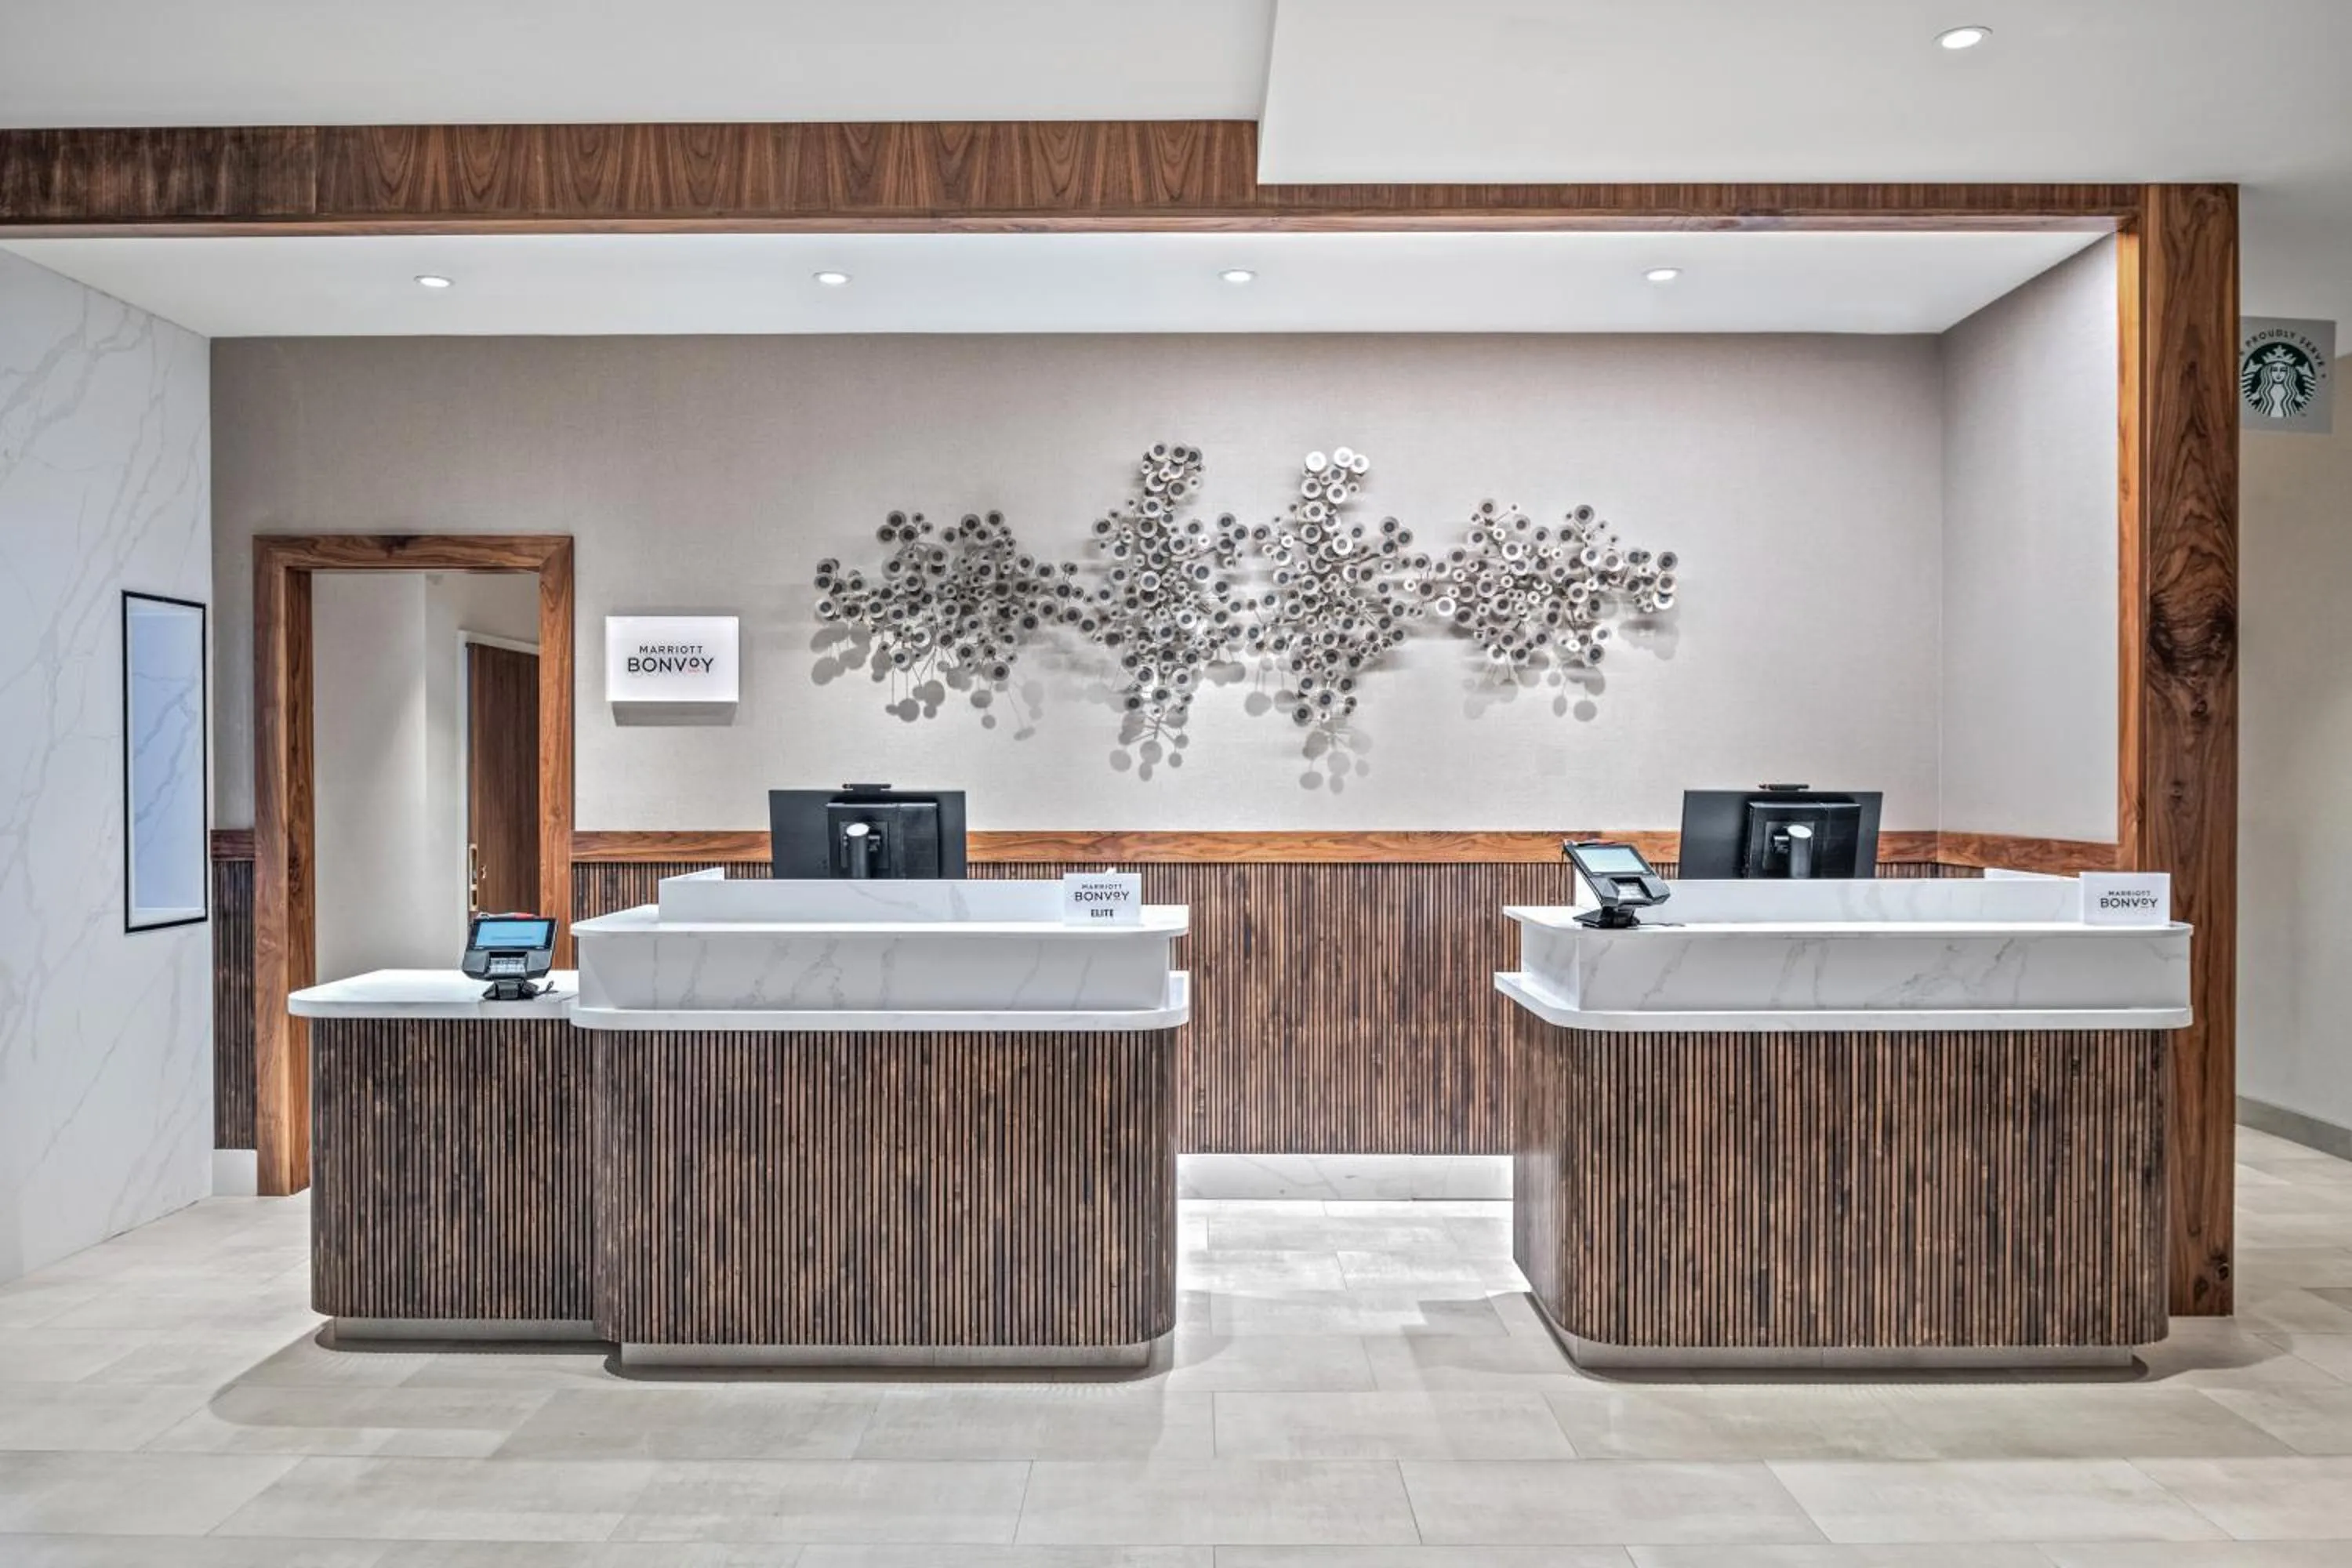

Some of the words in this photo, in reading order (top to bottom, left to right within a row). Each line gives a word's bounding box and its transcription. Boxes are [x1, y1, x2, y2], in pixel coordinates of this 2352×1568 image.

[2245, 328, 2296, 347] PROUDLY
[2299, 336, 2325, 368] SERVE
[639, 645, 703, 654] MARRIOTT
[628, 656, 714, 673] BONVOY
[1074, 891, 1129, 902] BONVOY
[2100, 898, 2158, 908] BONVOY
[1091, 909, 1113, 917] ELITE
